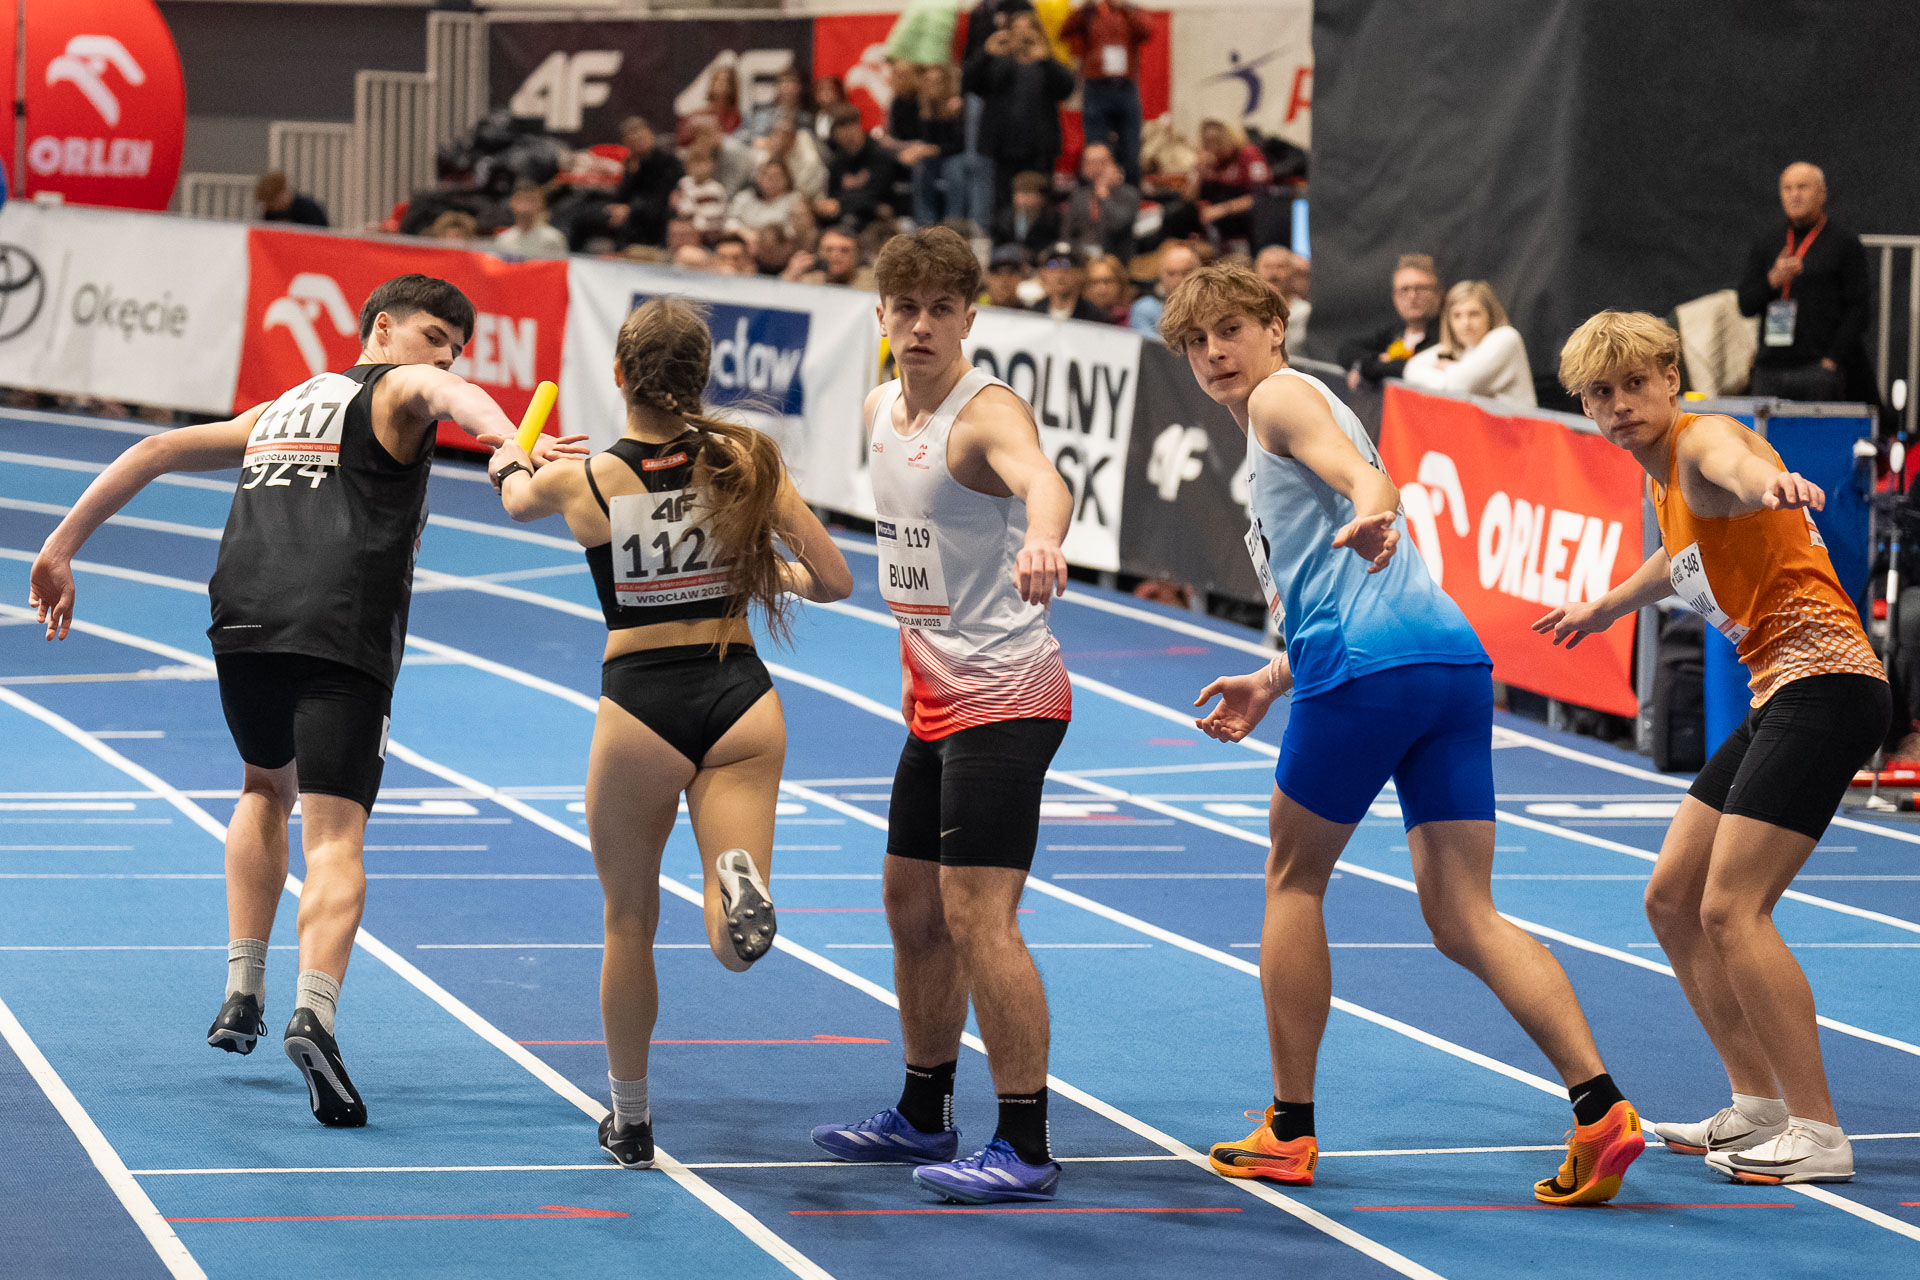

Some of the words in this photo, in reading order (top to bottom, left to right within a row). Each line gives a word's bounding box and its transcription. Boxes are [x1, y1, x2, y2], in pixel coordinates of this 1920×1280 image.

[509, 50, 625, 132] 4F
[28, 135, 153, 178] ORLEN
[72, 282, 189, 343] Okęcie
[255, 402, 342, 442] 1117
[299, 455, 322, 463] 2025
[651, 493, 697, 523] 4F
[904, 526, 930, 548] 119
[1478, 491, 1623, 607] ORLEN
[622, 528, 737, 578] 112
[1682, 552, 1700, 578] 548
[889, 563, 930, 591] BLUM
[636, 590, 699, 604] WROCŁAW
[701, 585, 728, 597] 2025
[922, 618, 941, 627] 2025
